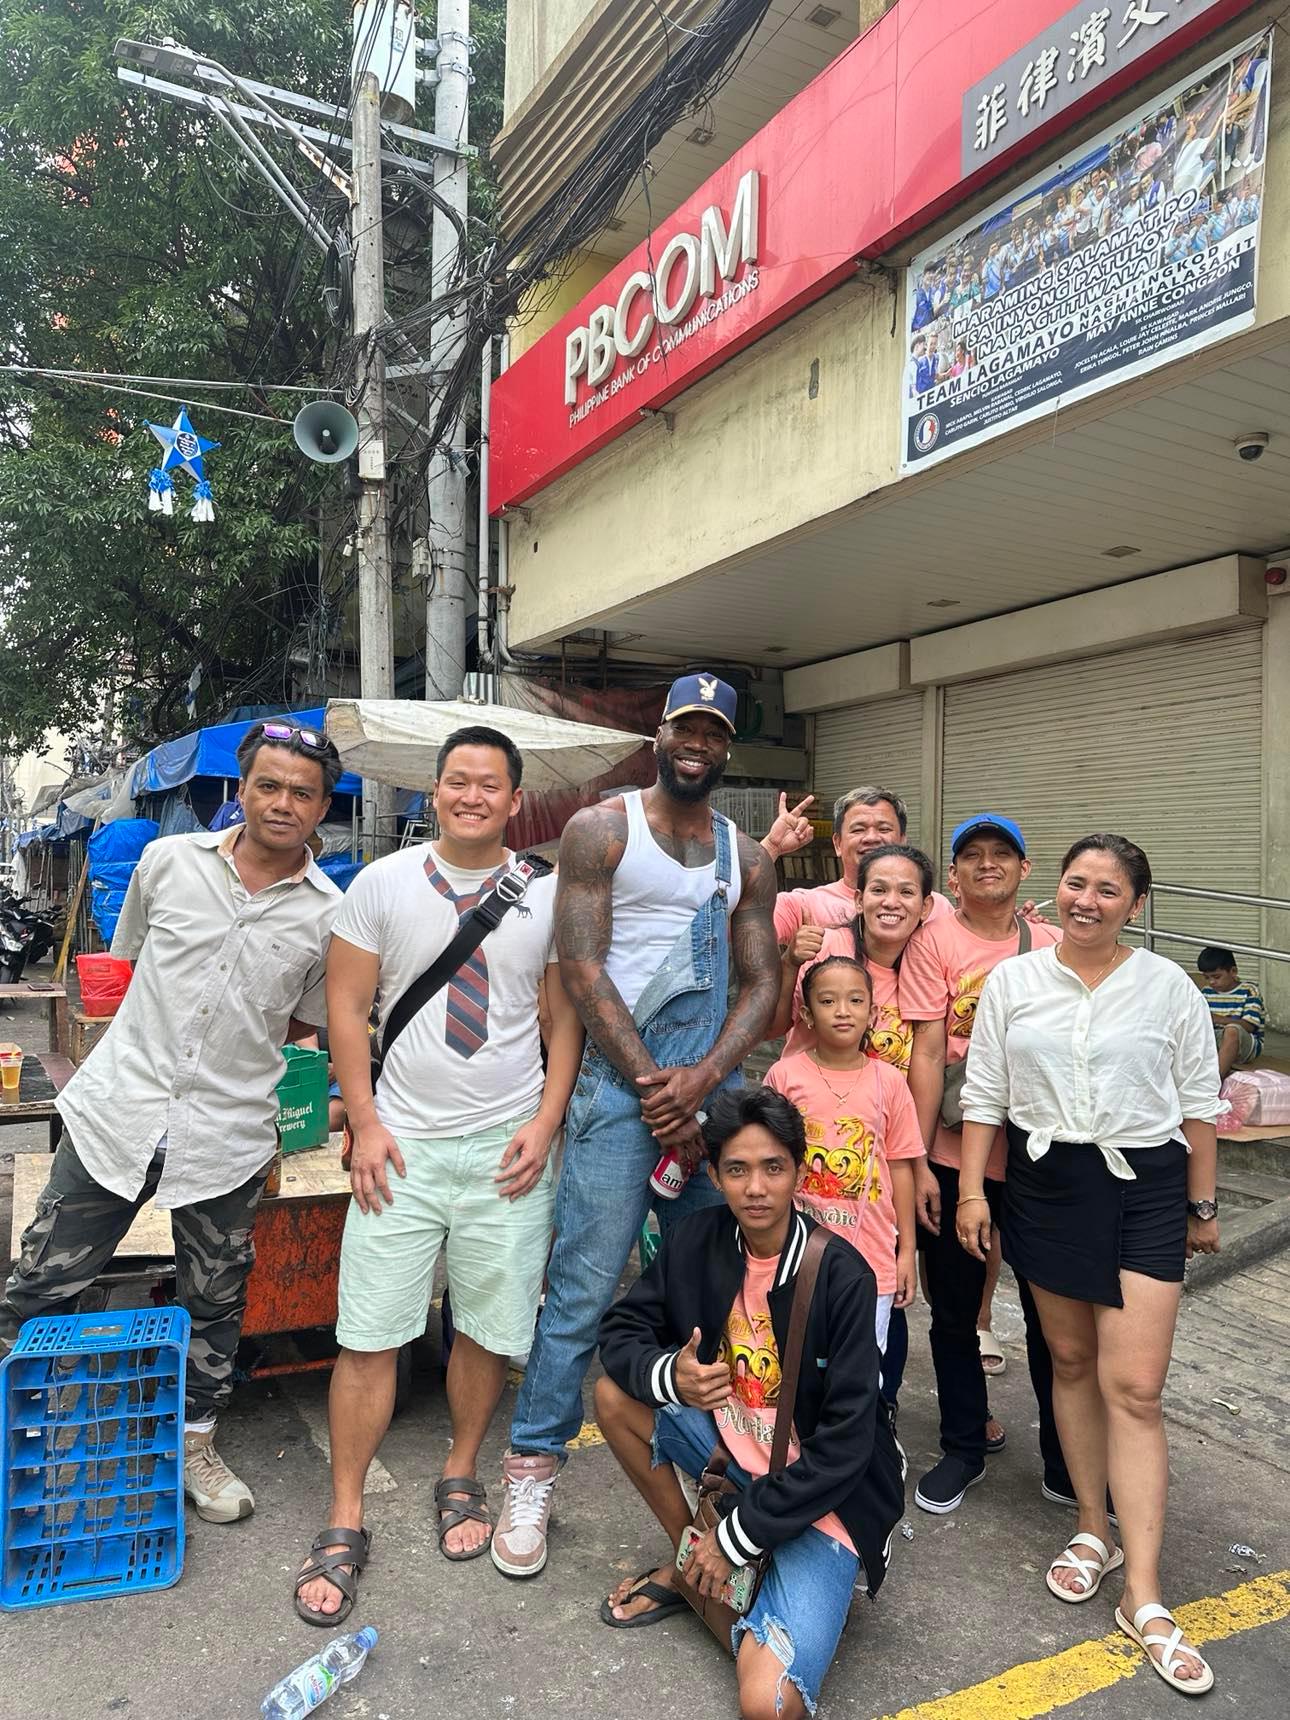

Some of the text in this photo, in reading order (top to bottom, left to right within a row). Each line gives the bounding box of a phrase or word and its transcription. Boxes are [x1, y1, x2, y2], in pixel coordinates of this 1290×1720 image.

[974, 0, 1183, 149] 菲律濱交
[565, 169, 759, 406] PBCOM
[953, 188, 1198, 339] MARAMING SALAMAT PO
[968, 220, 1175, 348] SA INYONG PATULOY
[978, 250, 1159, 360] NA PAGTITIWALA!
[1080, 246, 1219, 322] NAGLILINGKOD
[1080, 236, 1254, 332] NAGMAMALASAKIT
[1086, 256, 1240, 342] MAY ANNE CONGZON
[569, 270, 759, 428] PHILIPPINE BANK OF COMMUNICATIONS
[1074, 352, 1098, 370] JOCELYN
[1138, 329, 1150, 340] JAY
[1179, 307, 1198, 321] MARK
[1222, 280, 1253, 300] JUNGCO,
[1122, 342, 1140, 355] PETER
[1141, 334, 1159, 346] JOHN
[1143, 299, 1185, 321] CHAIRWOMAN
[1149, 310, 1180, 328] KAWAGAD
[916, 321, 1074, 410] TEAM LAGAMAYO
[950, 348, 1060, 408] SENCIO LAGAMAYO
[275, 1120, 306, 1133] rewery
[282, 1101, 313, 1121] Miguel
